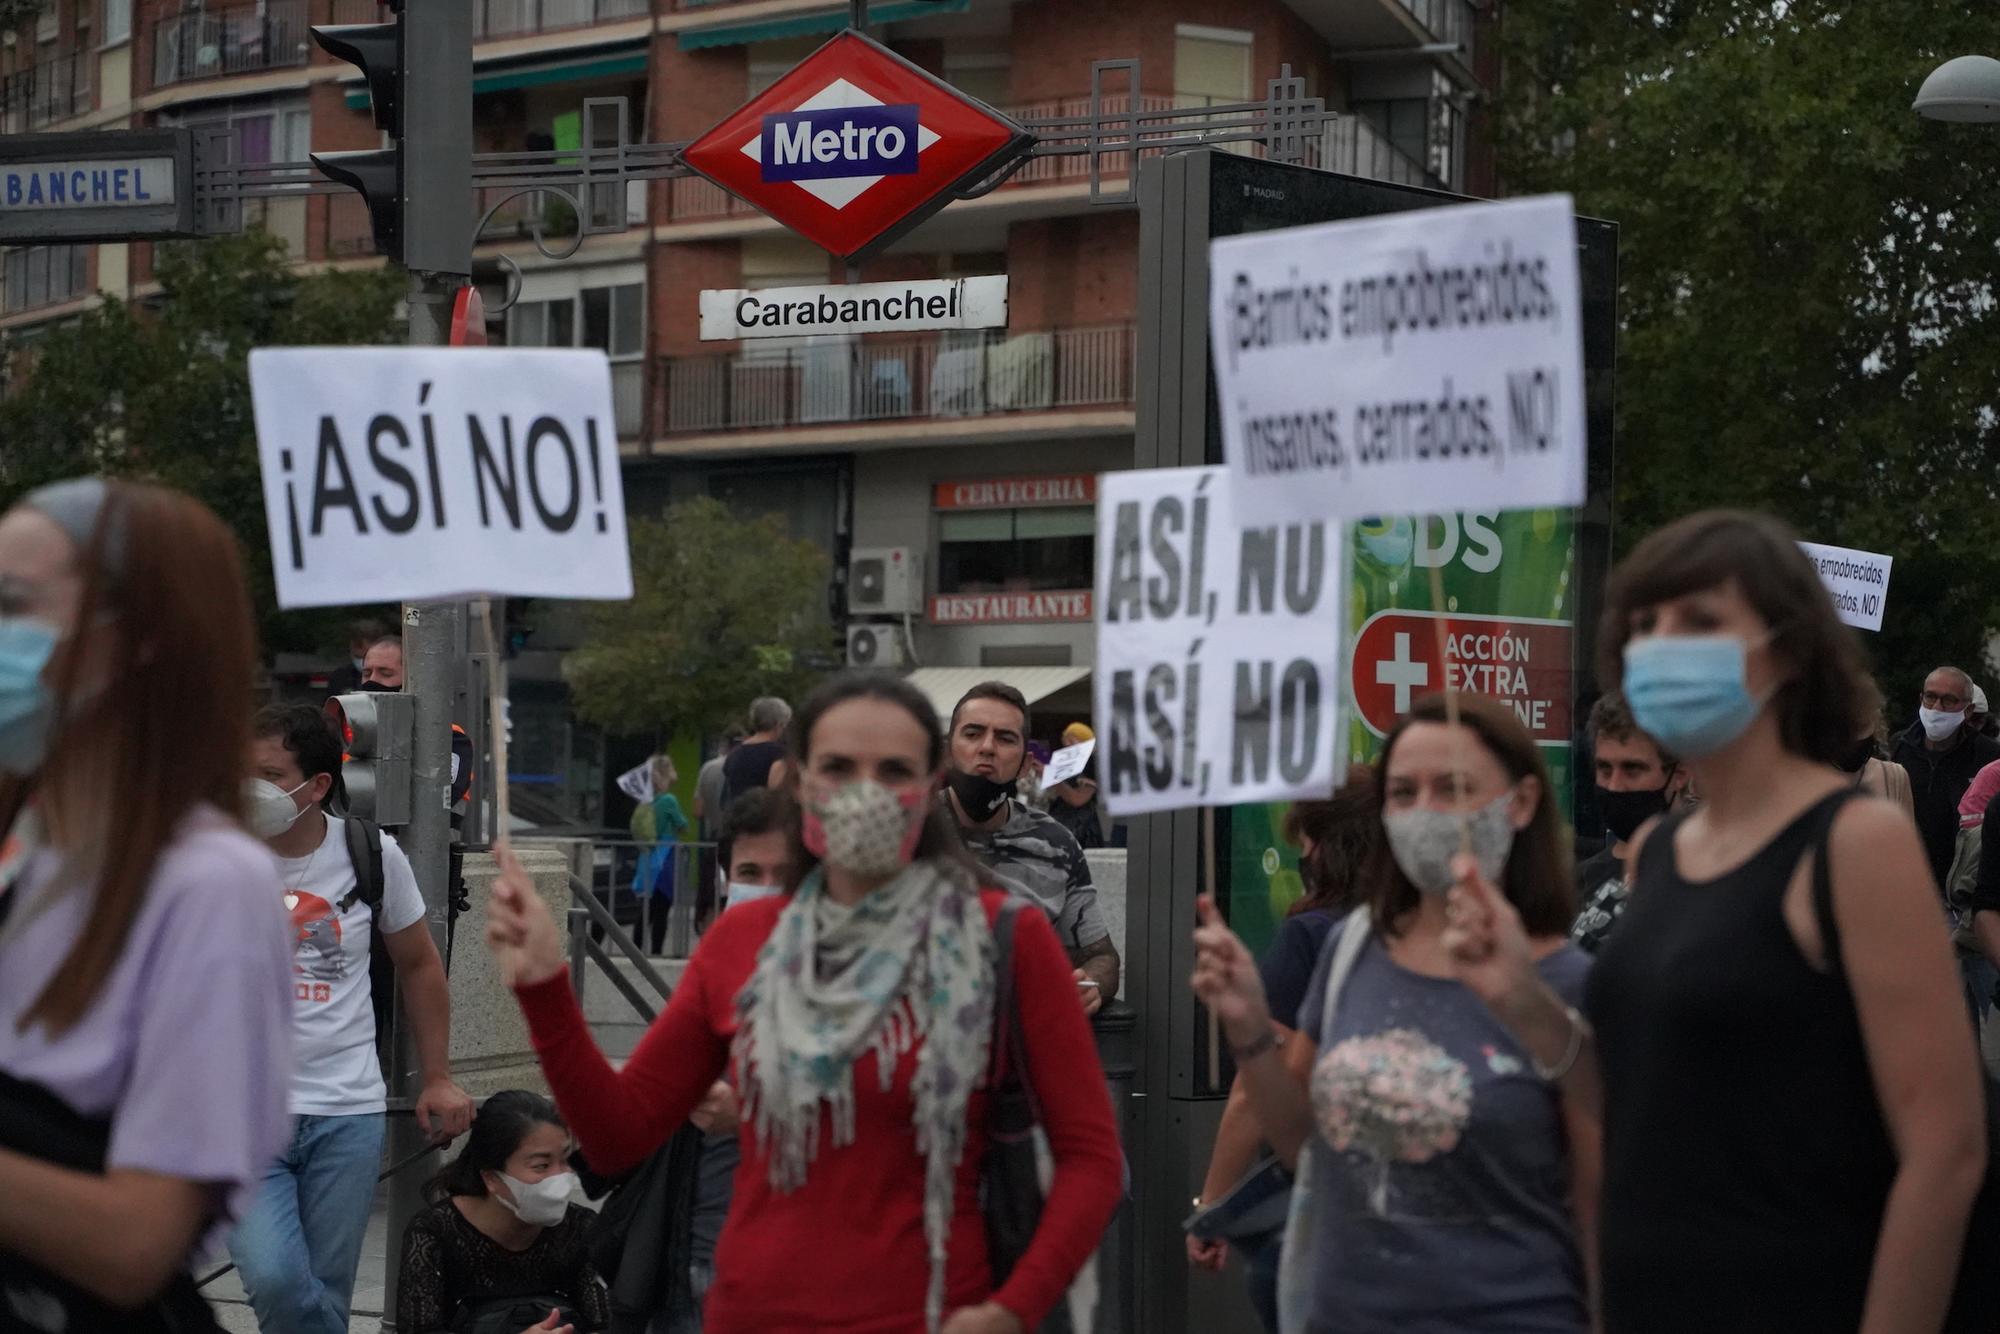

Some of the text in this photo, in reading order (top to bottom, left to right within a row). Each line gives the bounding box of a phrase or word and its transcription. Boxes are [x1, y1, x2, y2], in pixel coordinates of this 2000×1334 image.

[774, 121, 905, 165] Metro
[0, 168, 151, 206] BANCHEL
[736, 287, 956, 327] Carabanchel
[1507, 366, 1561, 453] NO!
[282, 381, 606, 571] ¡ASÍ NO!
[955, 478, 1085, 504] CERVECERIA
[1106, 474, 1217, 626] ASÍ,
[1821, 557, 1884, 589] empobrecidos,
[936, 594, 1085, 621] RESTAURANTE
[1833, 590, 1880, 616] rados, NO!
[1445, 630, 1529, 662] ACCIÓN
[1446, 663, 1529, 695] EXTRA
[1109, 638, 1320, 795] ASÍ, NO
